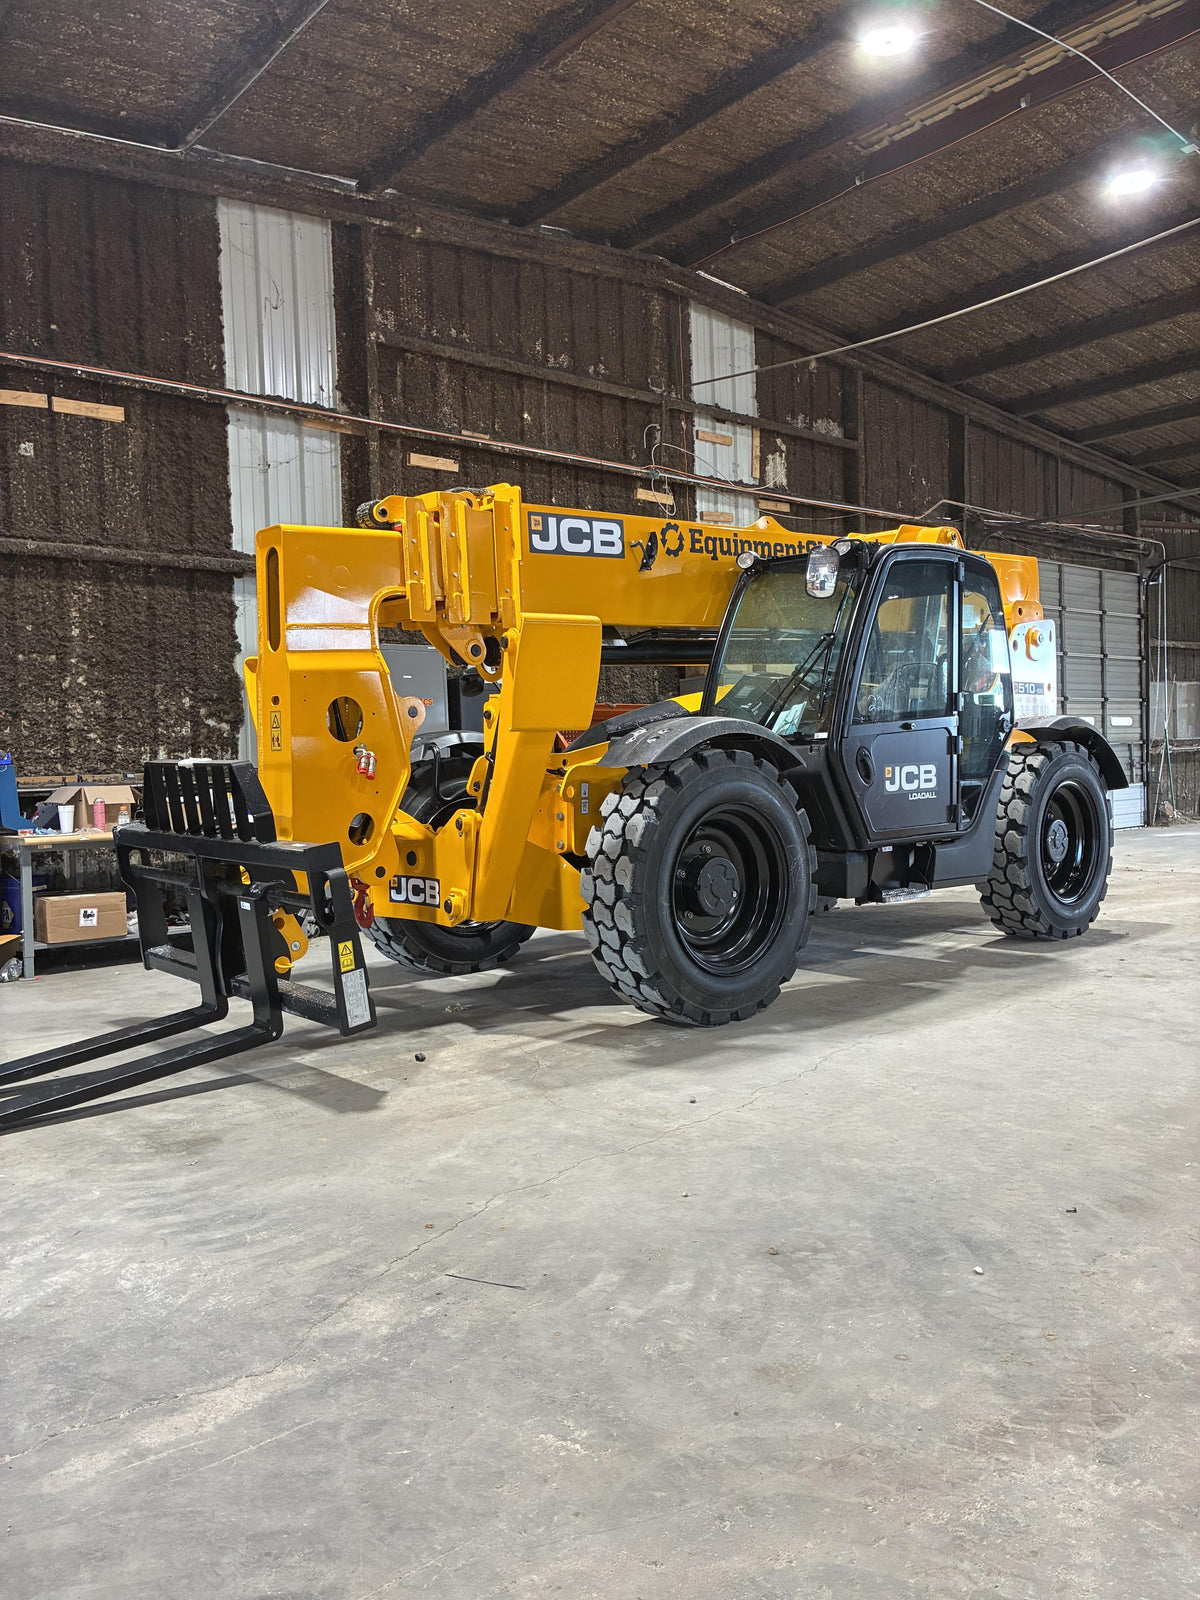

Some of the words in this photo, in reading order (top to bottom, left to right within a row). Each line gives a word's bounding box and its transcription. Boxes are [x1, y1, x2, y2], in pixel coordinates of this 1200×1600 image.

[531, 516, 623, 555] JCB
[885, 764, 936, 791] JCB
[908, 791, 937, 800] LOADALL
[390, 877, 440, 905] JCB
